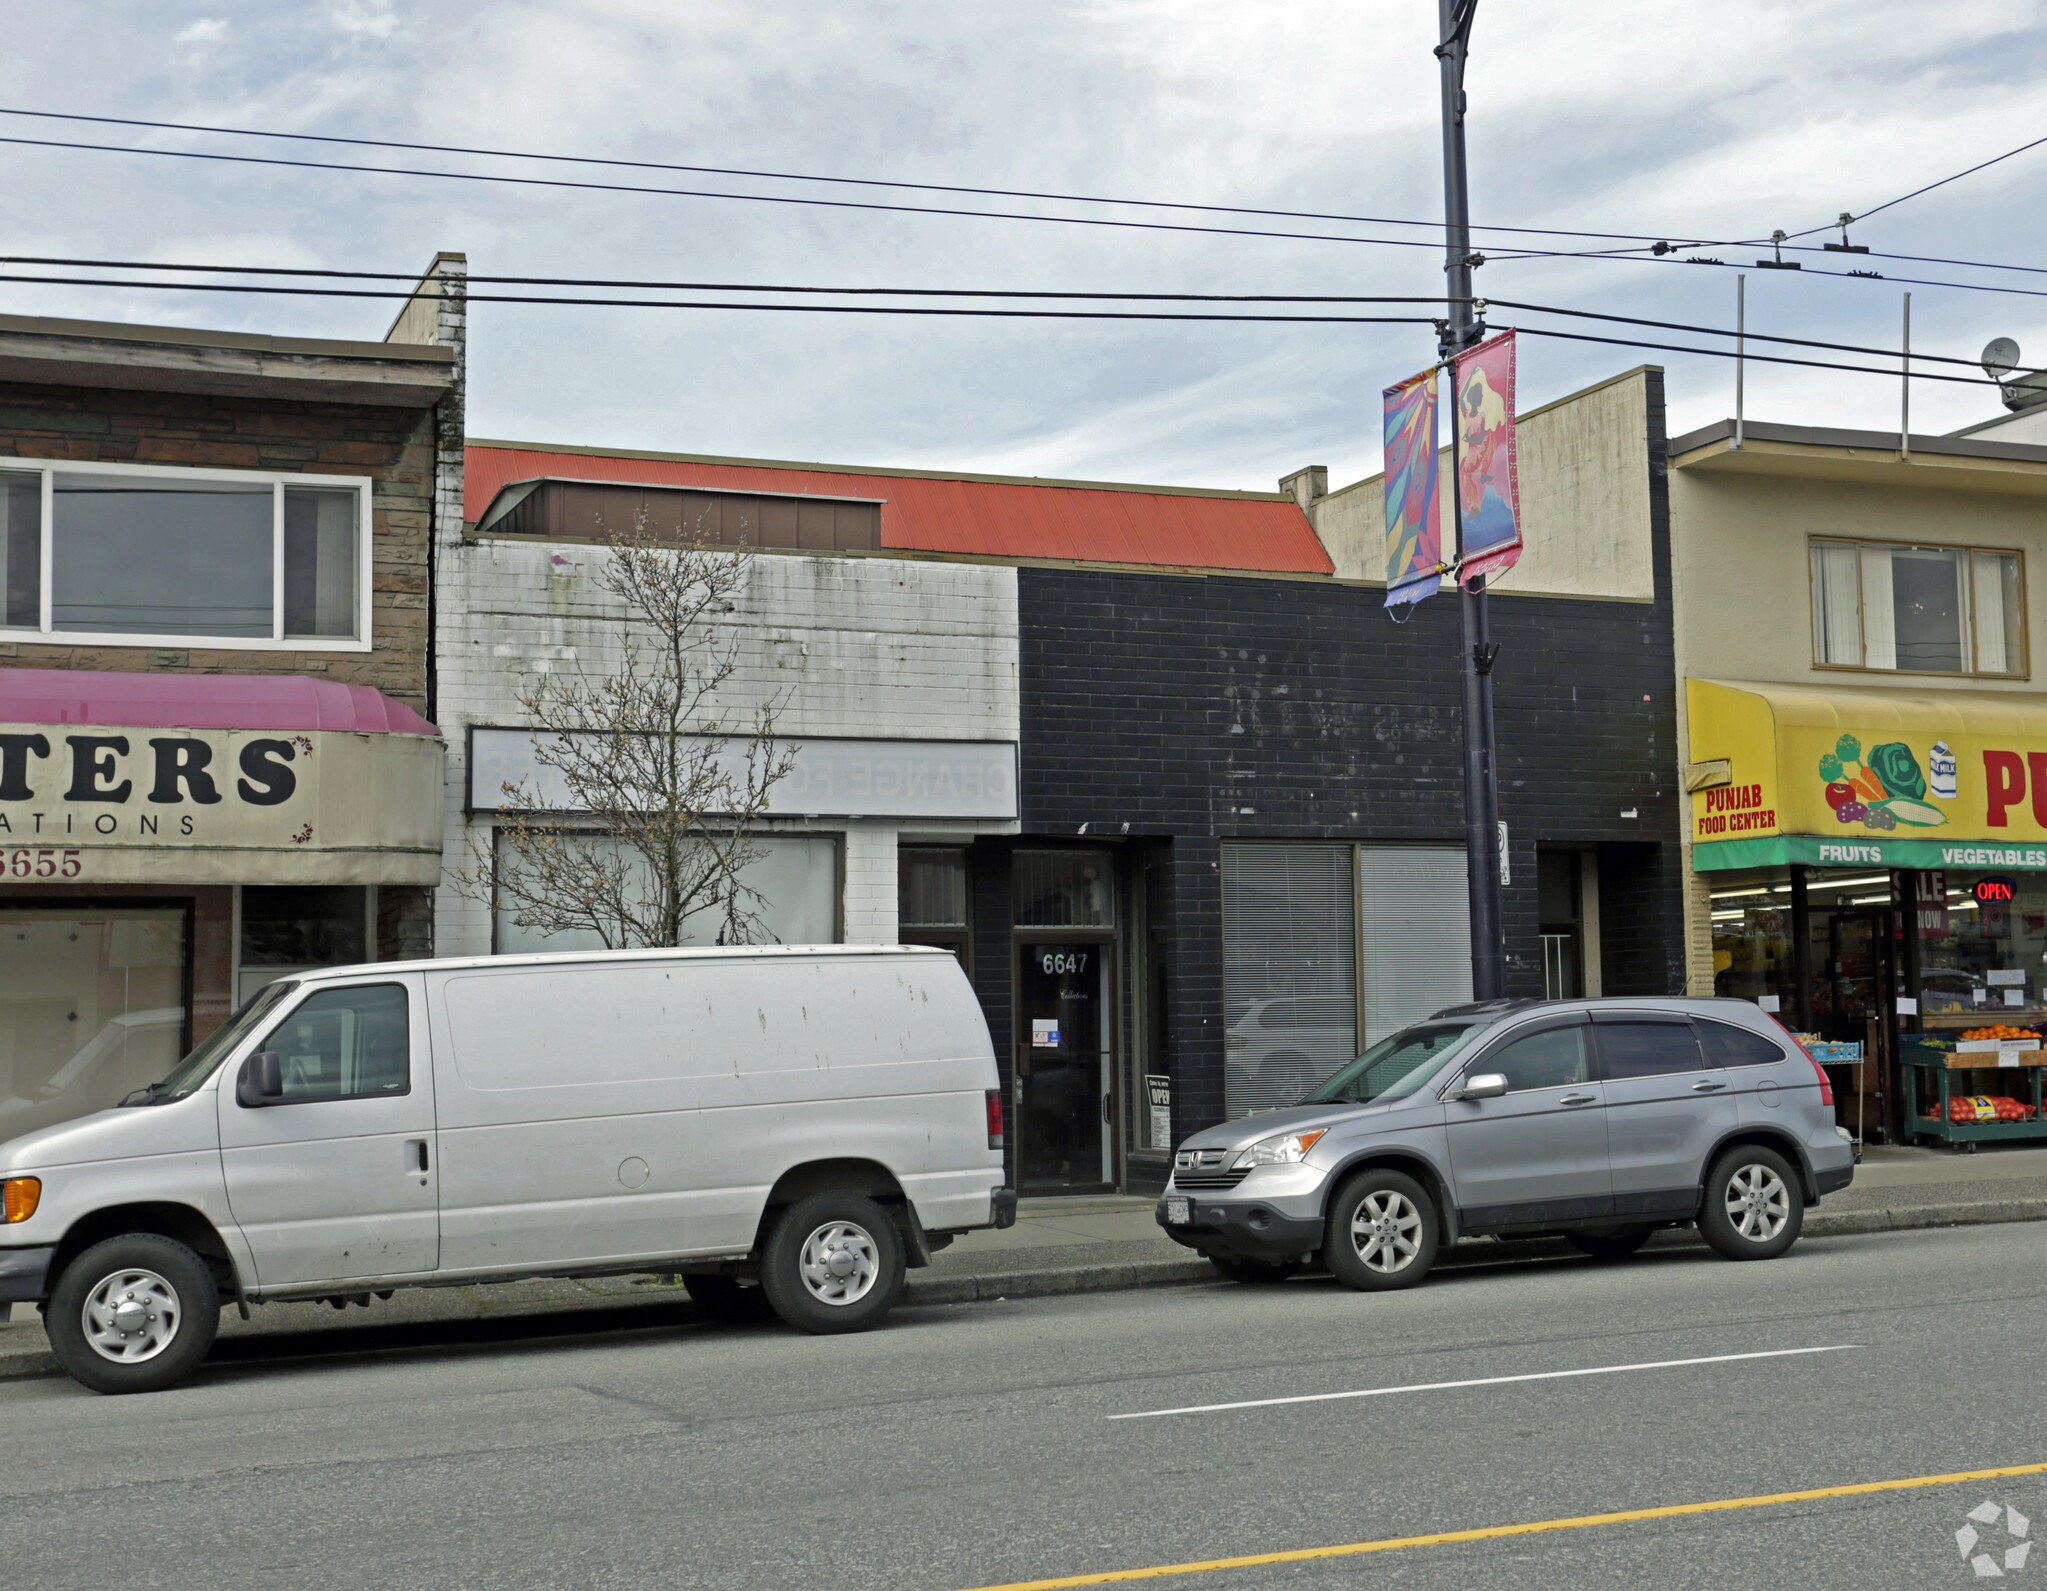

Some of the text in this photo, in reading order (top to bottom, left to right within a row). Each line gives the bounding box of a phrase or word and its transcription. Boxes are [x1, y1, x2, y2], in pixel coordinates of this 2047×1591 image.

[0, 733, 297, 806] TERS
[1705, 783, 1762, 813] PUNJAB
[0, 813, 194, 836] ATIONS
[1698, 809, 1776, 835] FOOD CENTER
[0, 849, 83, 878] 655
[1818, 844, 2047, 867] FRUITS VEGETABLES
[1893, 870, 1944, 901] SLE
[1977, 882, 2012, 901] OPEN
[1917, 910, 1941, 929] NOW
[1043, 953, 1088, 975] 6647
